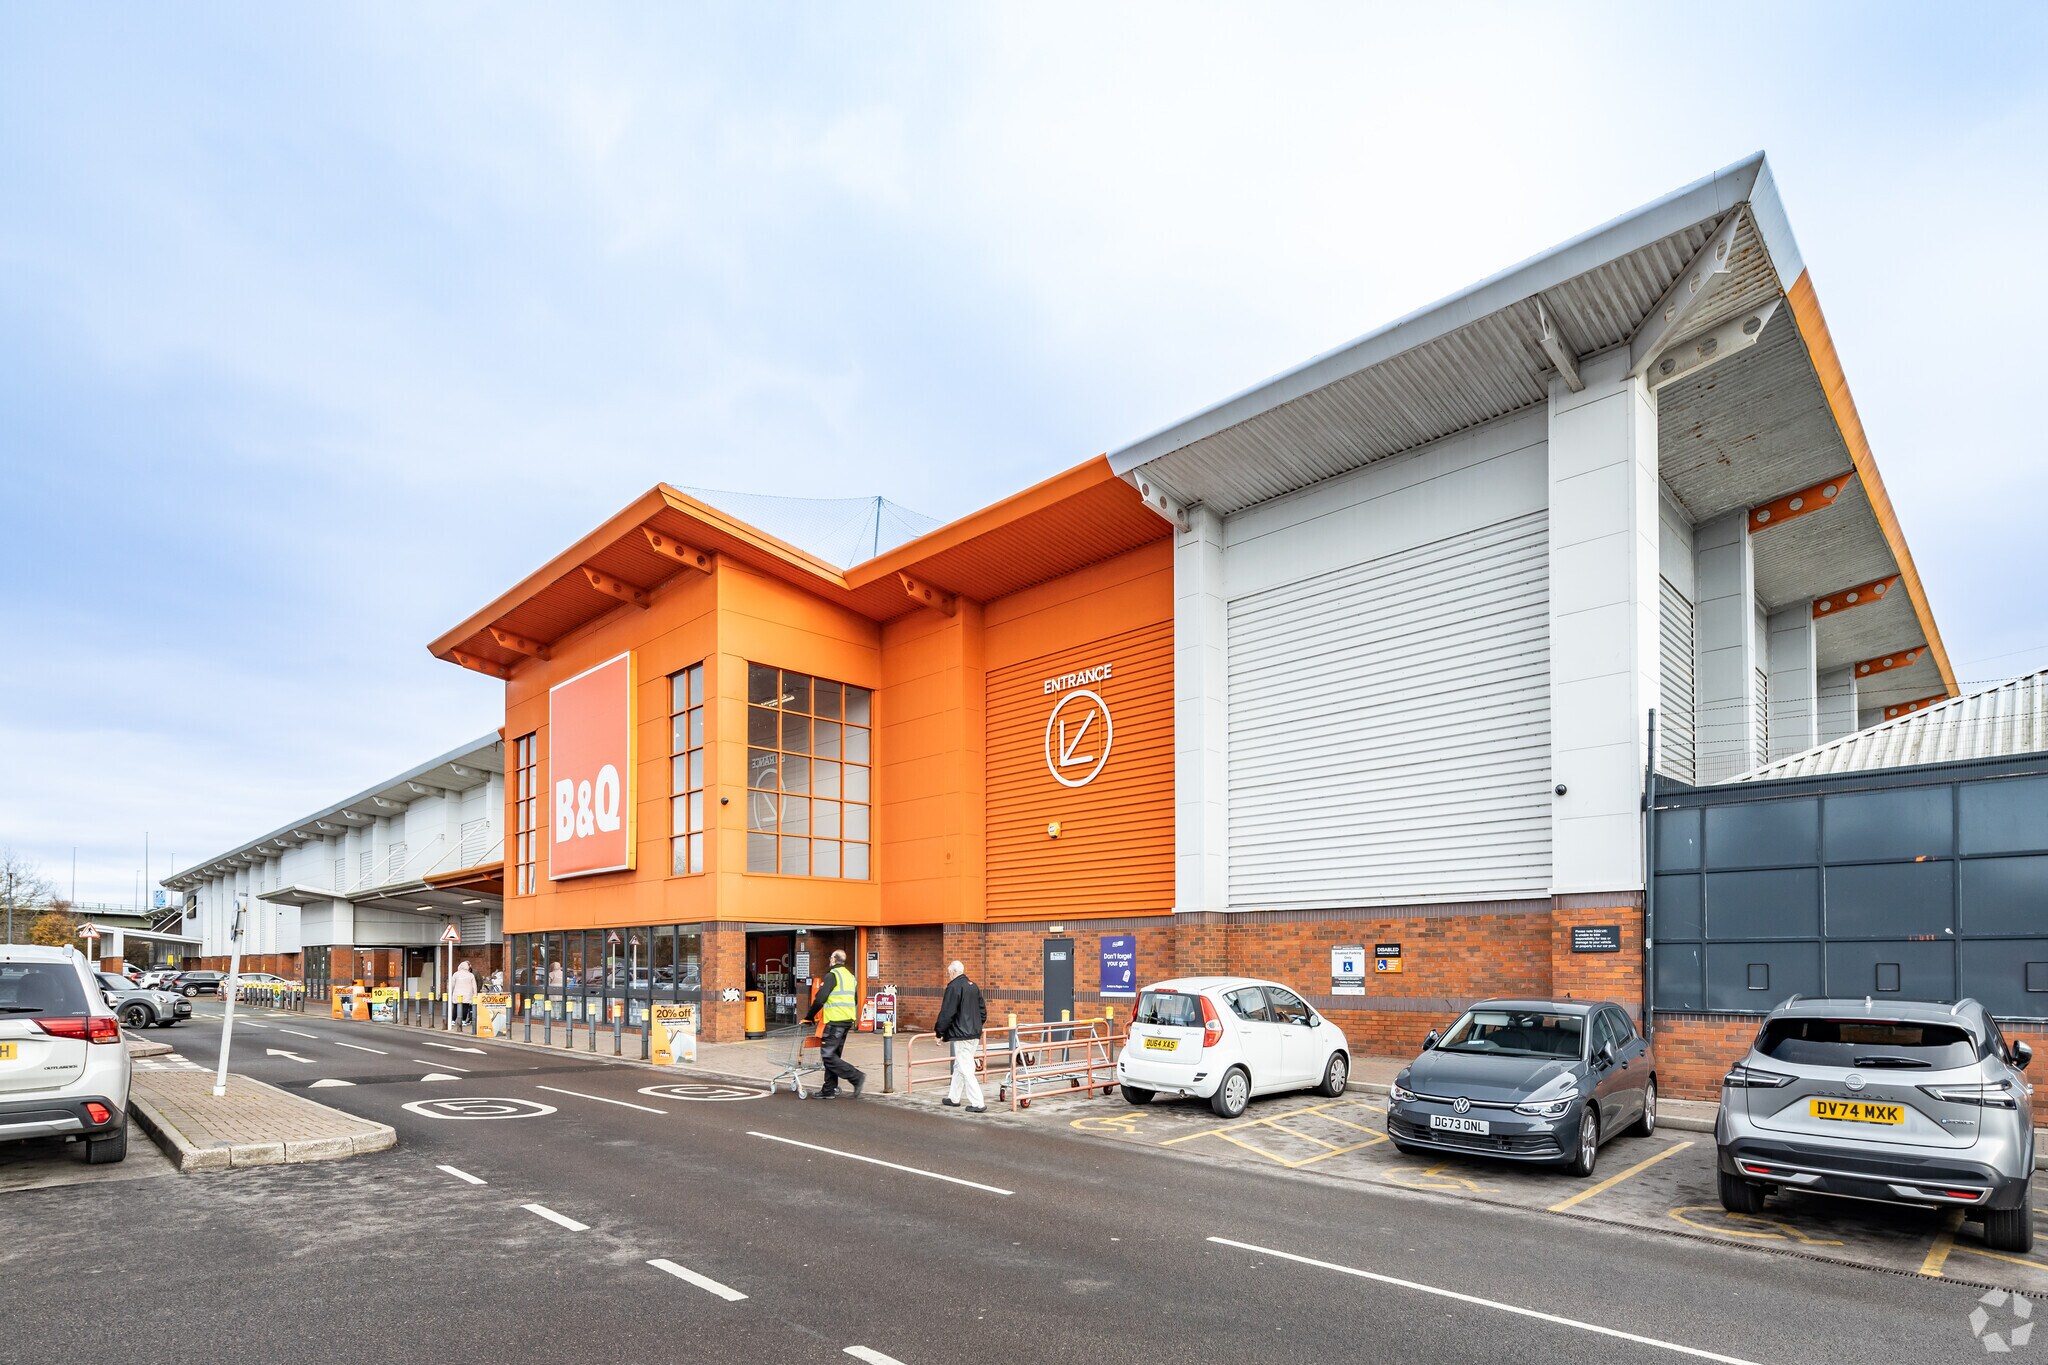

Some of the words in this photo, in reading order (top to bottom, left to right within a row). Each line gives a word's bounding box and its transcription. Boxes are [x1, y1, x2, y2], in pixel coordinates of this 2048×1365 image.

[1044, 663, 1113, 695] ENTRANCE
[556, 764, 620, 844] B&Q
[1117, 953, 1132, 961] forget
[656, 1009, 678, 1018] 20%
[678, 1008, 692, 1018] off
[1162, 1041, 1175, 1049] XAS
[1817, 1101, 1860, 1118] DV74
[1864, 1105, 1898, 1121] MXK
[1435, 1116, 1461, 1130] DG73
[1463, 1120, 1485, 1133] ONL
